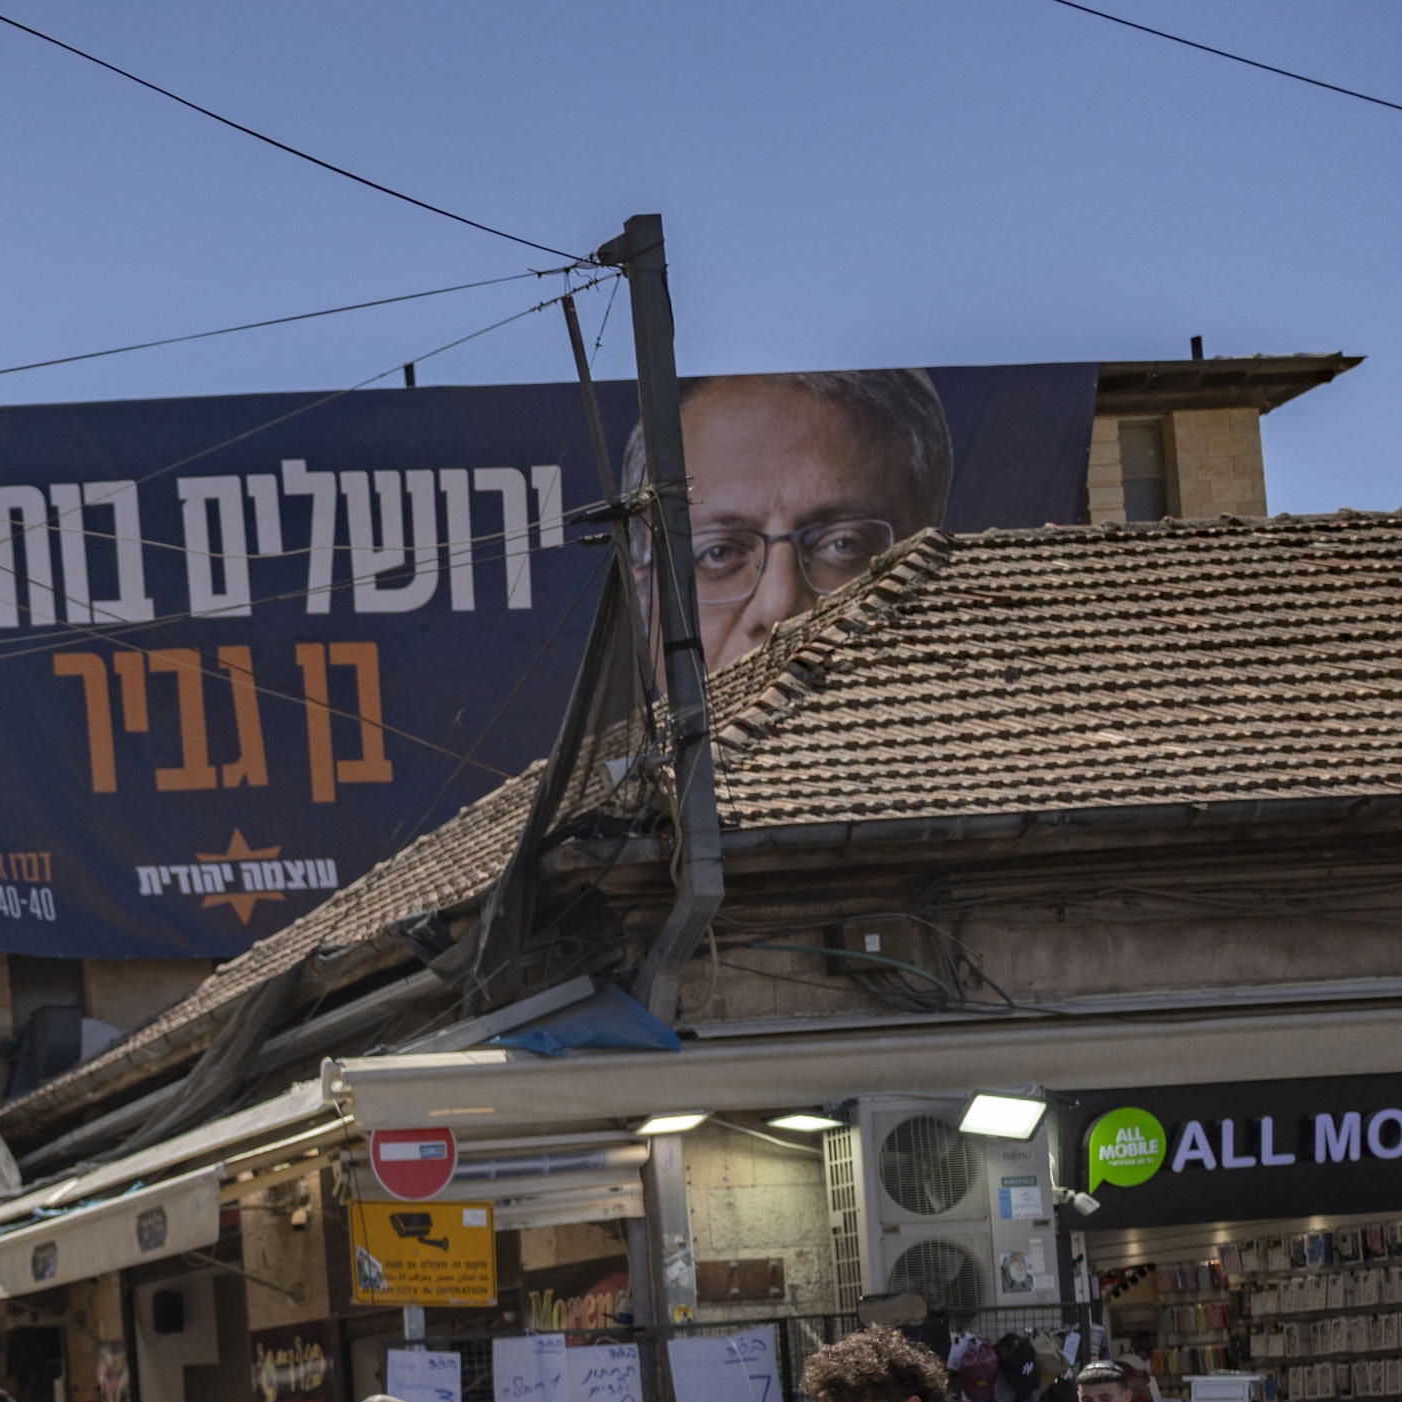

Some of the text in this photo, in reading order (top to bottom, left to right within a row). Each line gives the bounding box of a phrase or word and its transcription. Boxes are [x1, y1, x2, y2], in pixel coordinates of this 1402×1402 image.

[177, 459, 564, 618] ירושלים
[53, 641, 393, 803] בן גביר
[135, 857, 338, 896] עוצמה יהודית
[1099, 1138, 1159, 1161] MOBILE
[1115, 1126, 1145, 1144] ALL
[1172, 1115, 1296, 1173] ALL
